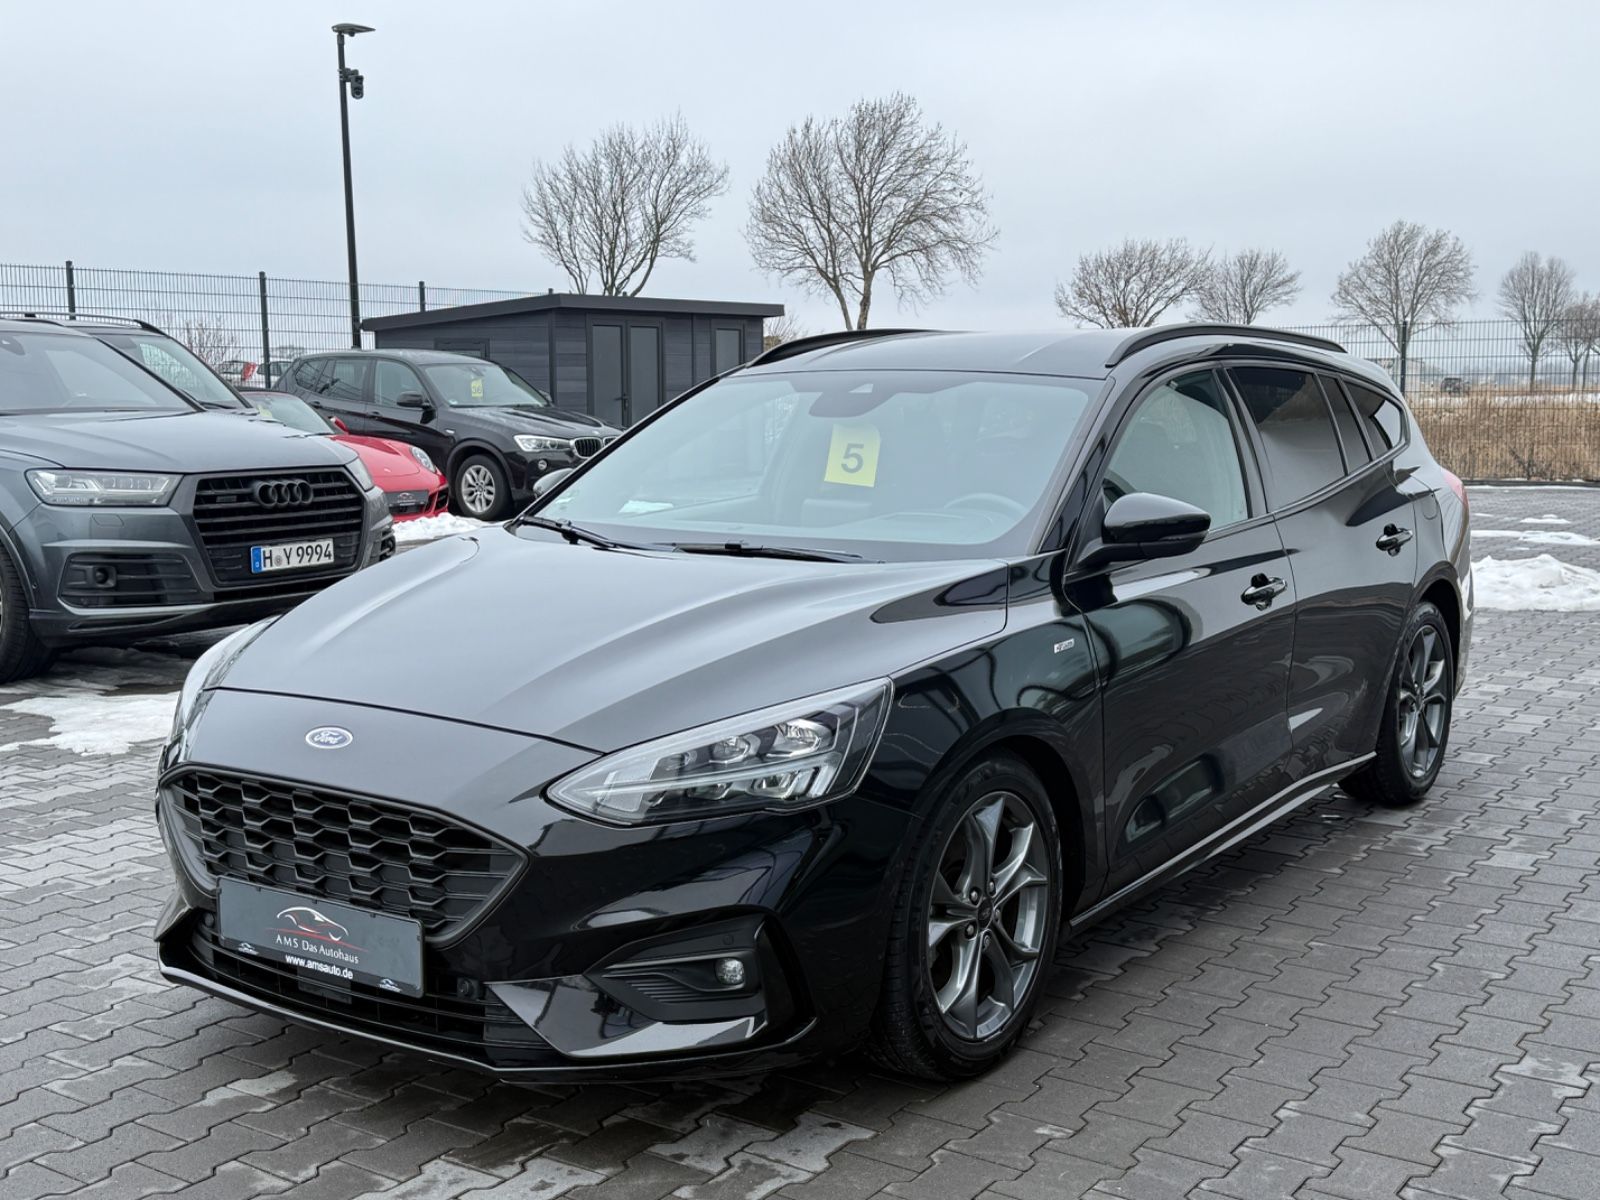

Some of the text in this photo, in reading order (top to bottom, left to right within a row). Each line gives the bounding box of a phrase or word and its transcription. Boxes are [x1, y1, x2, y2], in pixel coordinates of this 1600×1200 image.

[841, 443, 864, 473] 5
[262, 543, 332, 568] H Y 9994
[301, 939, 319, 953] Das
[319, 945, 360, 965] Autohaus
[285, 953, 354, 980] www.amsauto.de
